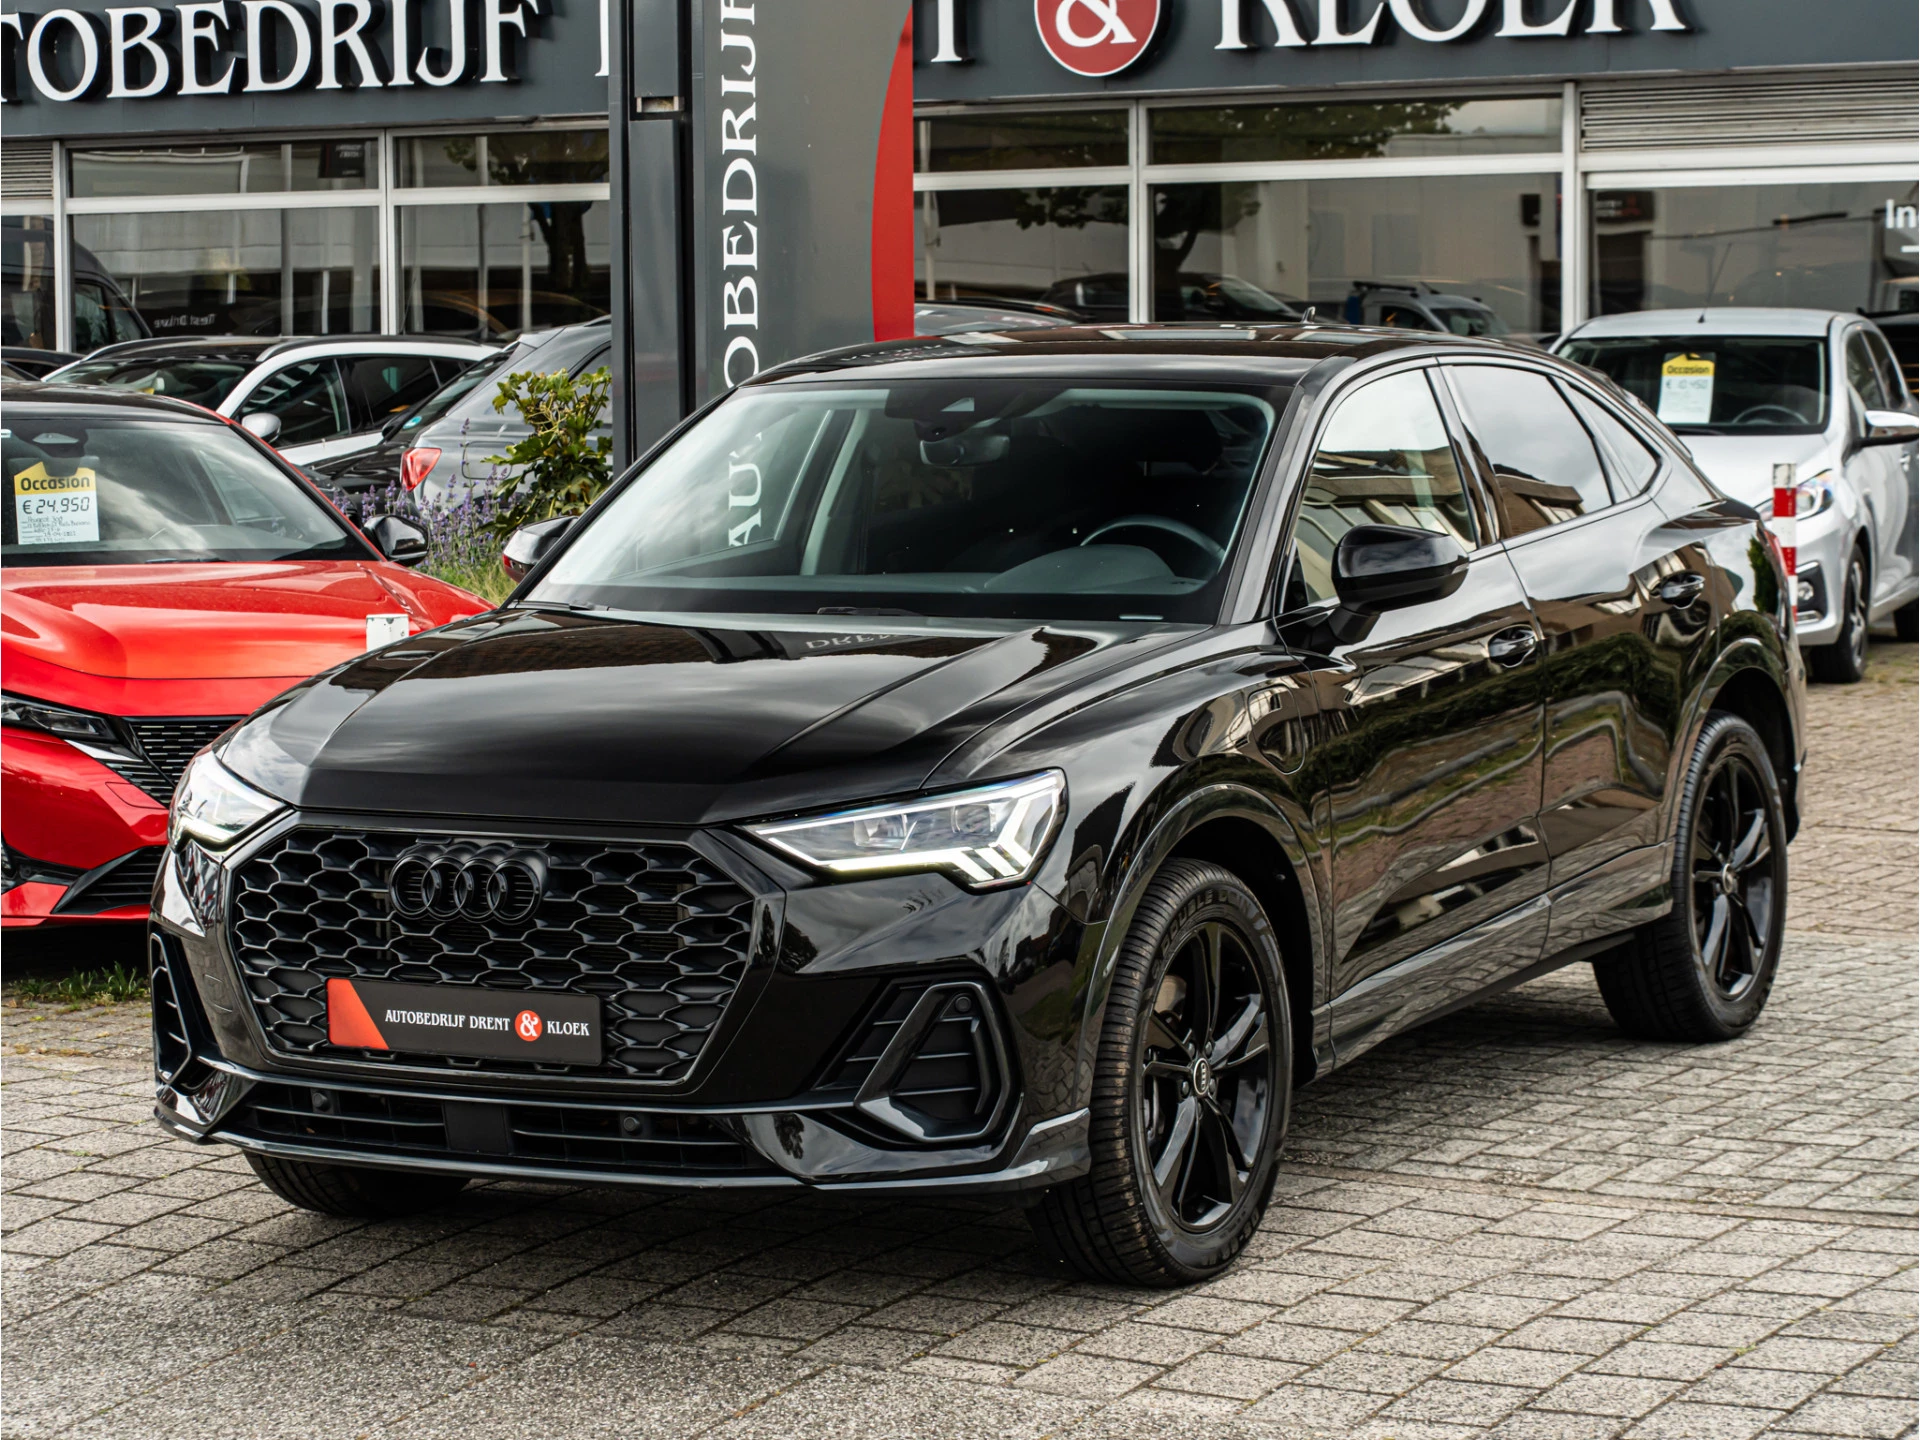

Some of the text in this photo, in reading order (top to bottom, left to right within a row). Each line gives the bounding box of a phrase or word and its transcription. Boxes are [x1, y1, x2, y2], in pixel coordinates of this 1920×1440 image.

[1886, 199, 1919, 229] In
[20, 477, 90, 491] Occasion
[22, 496, 90, 515] € 24.950
[385, 1009, 590, 1037] AUTOBEDRIJF DRENT & KLOEK
